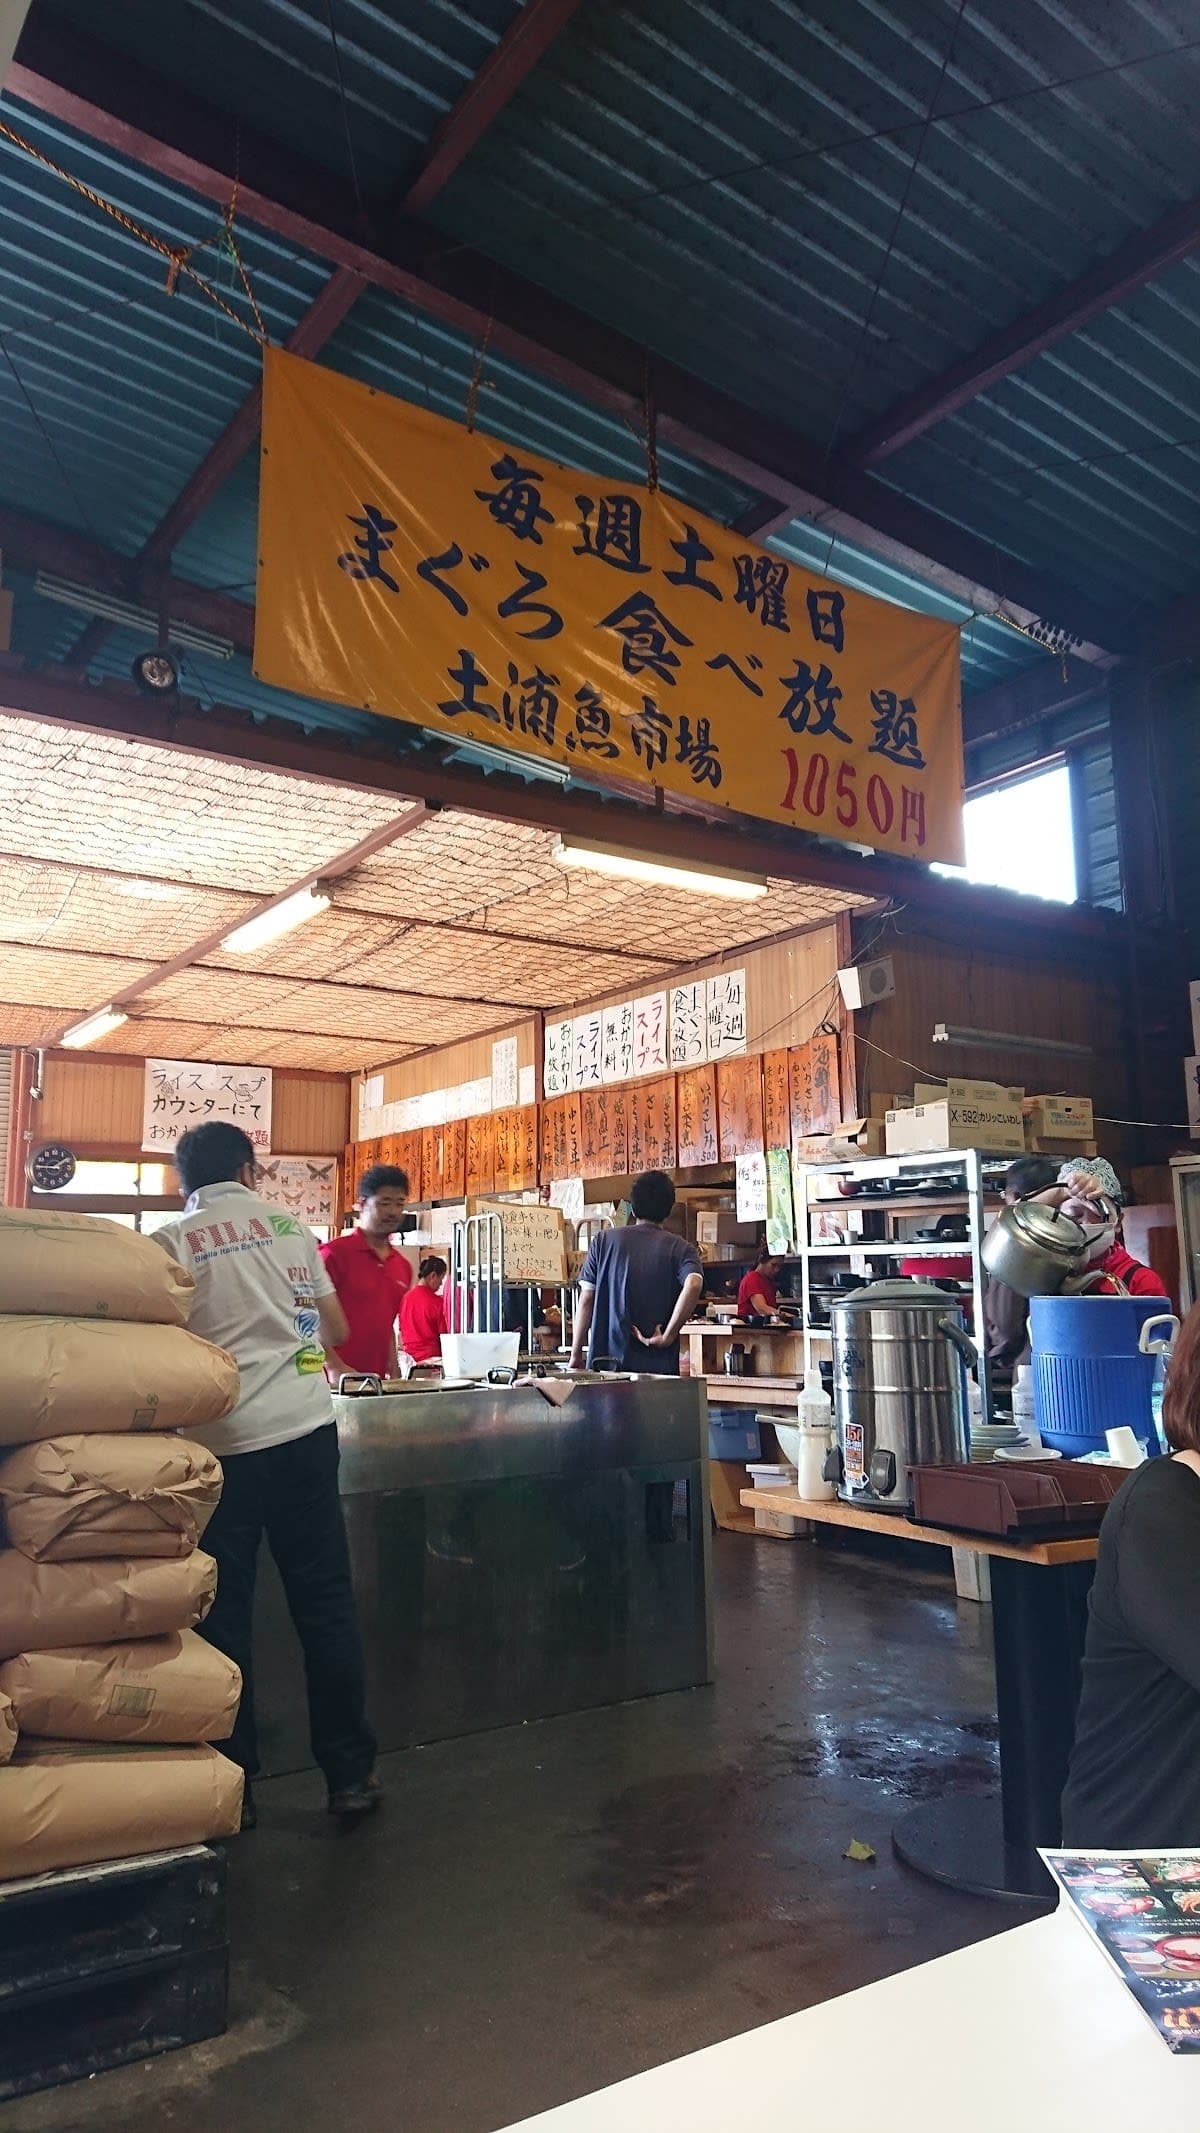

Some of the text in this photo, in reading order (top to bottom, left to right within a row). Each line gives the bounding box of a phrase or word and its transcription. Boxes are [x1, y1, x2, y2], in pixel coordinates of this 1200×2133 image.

[474, 453, 845, 653] 毎週土曜日
[338, 504, 927, 770] まぐろ食べ放題
[437, 649, 723, 789] 土浦魚市場
[780, 747, 926, 847] 1050円
[560, 1023, 571, 1090] おかわり
[576, 1034, 589, 1085] スープ
[589, 1021, 600, 1079] ライス
[604, 1022, 617, 1072] 無料
[621, 1006, 632, 1076] おかわり
[637, 1012, 650, 1068] スープ
[652, 999, 665, 1064] ライス
[152, 1069, 267, 1093] ライス スープ
[152, 1094, 262, 1121] カウンターにて
[951, 1109, 1021, 1125] X-592 カリッこいわし
[184, 1217, 273, 1255] FILA
